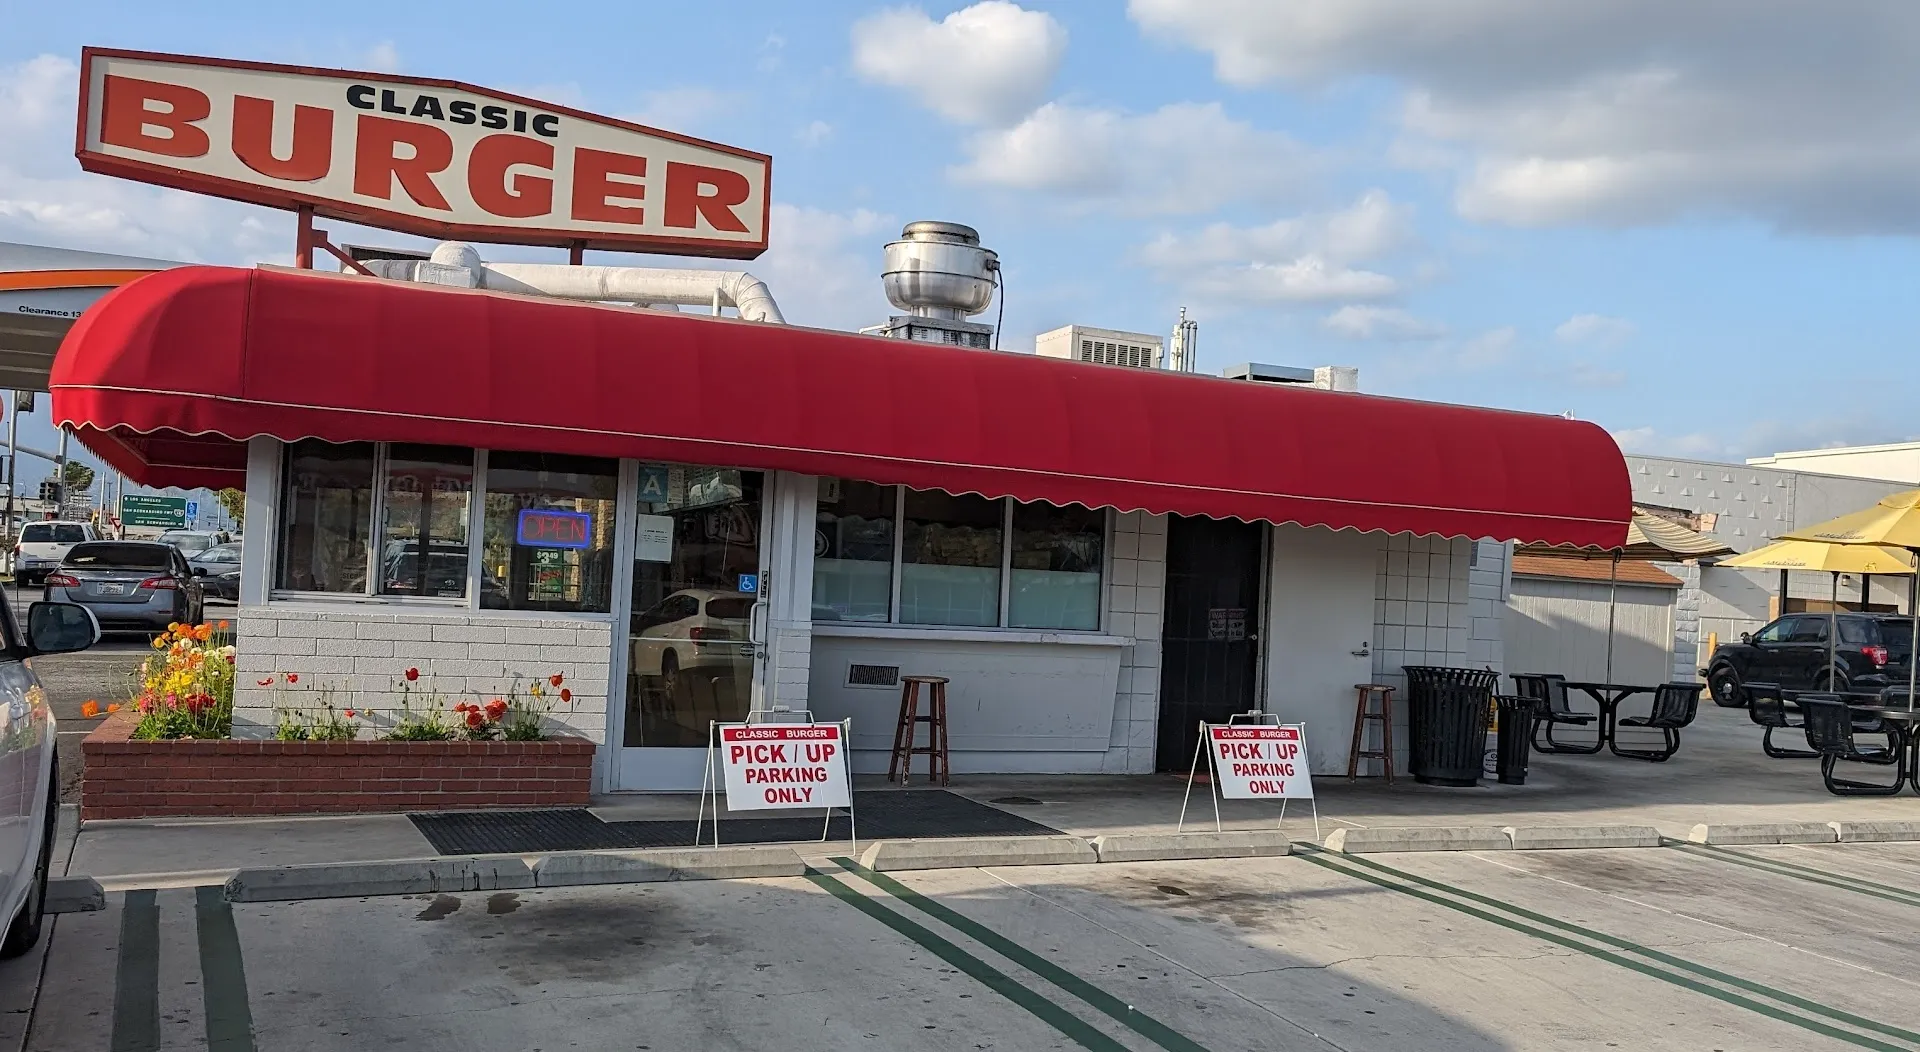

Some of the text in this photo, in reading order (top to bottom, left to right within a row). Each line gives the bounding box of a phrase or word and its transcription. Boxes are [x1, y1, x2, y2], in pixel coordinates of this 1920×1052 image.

[346, 84, 559, 138] CLASSIC
[100, 74, 751, 234] BURGER
[18, 305, 69, 317] Clearance
[642, 474, 662, 496] A
[523, 514, 585, 541] OPEN
[735, 729, 828, 739] CLASSIC BURGER
[1221, 730, 1291, 739] CLASSIC BURGER
[730, 744, 787, 765] PICK
[805, 743, 835, 763] UP
[1219, 743, 1263, 760] PICK
[1275, 743, 1298, 760] UP
[745, 766, 828, 784] PARKING
[1233, 763, 1295, 777] PARKING
[764, 787, 812, 804] ONLY
[1249, 780, 1285, 794] ONLY
